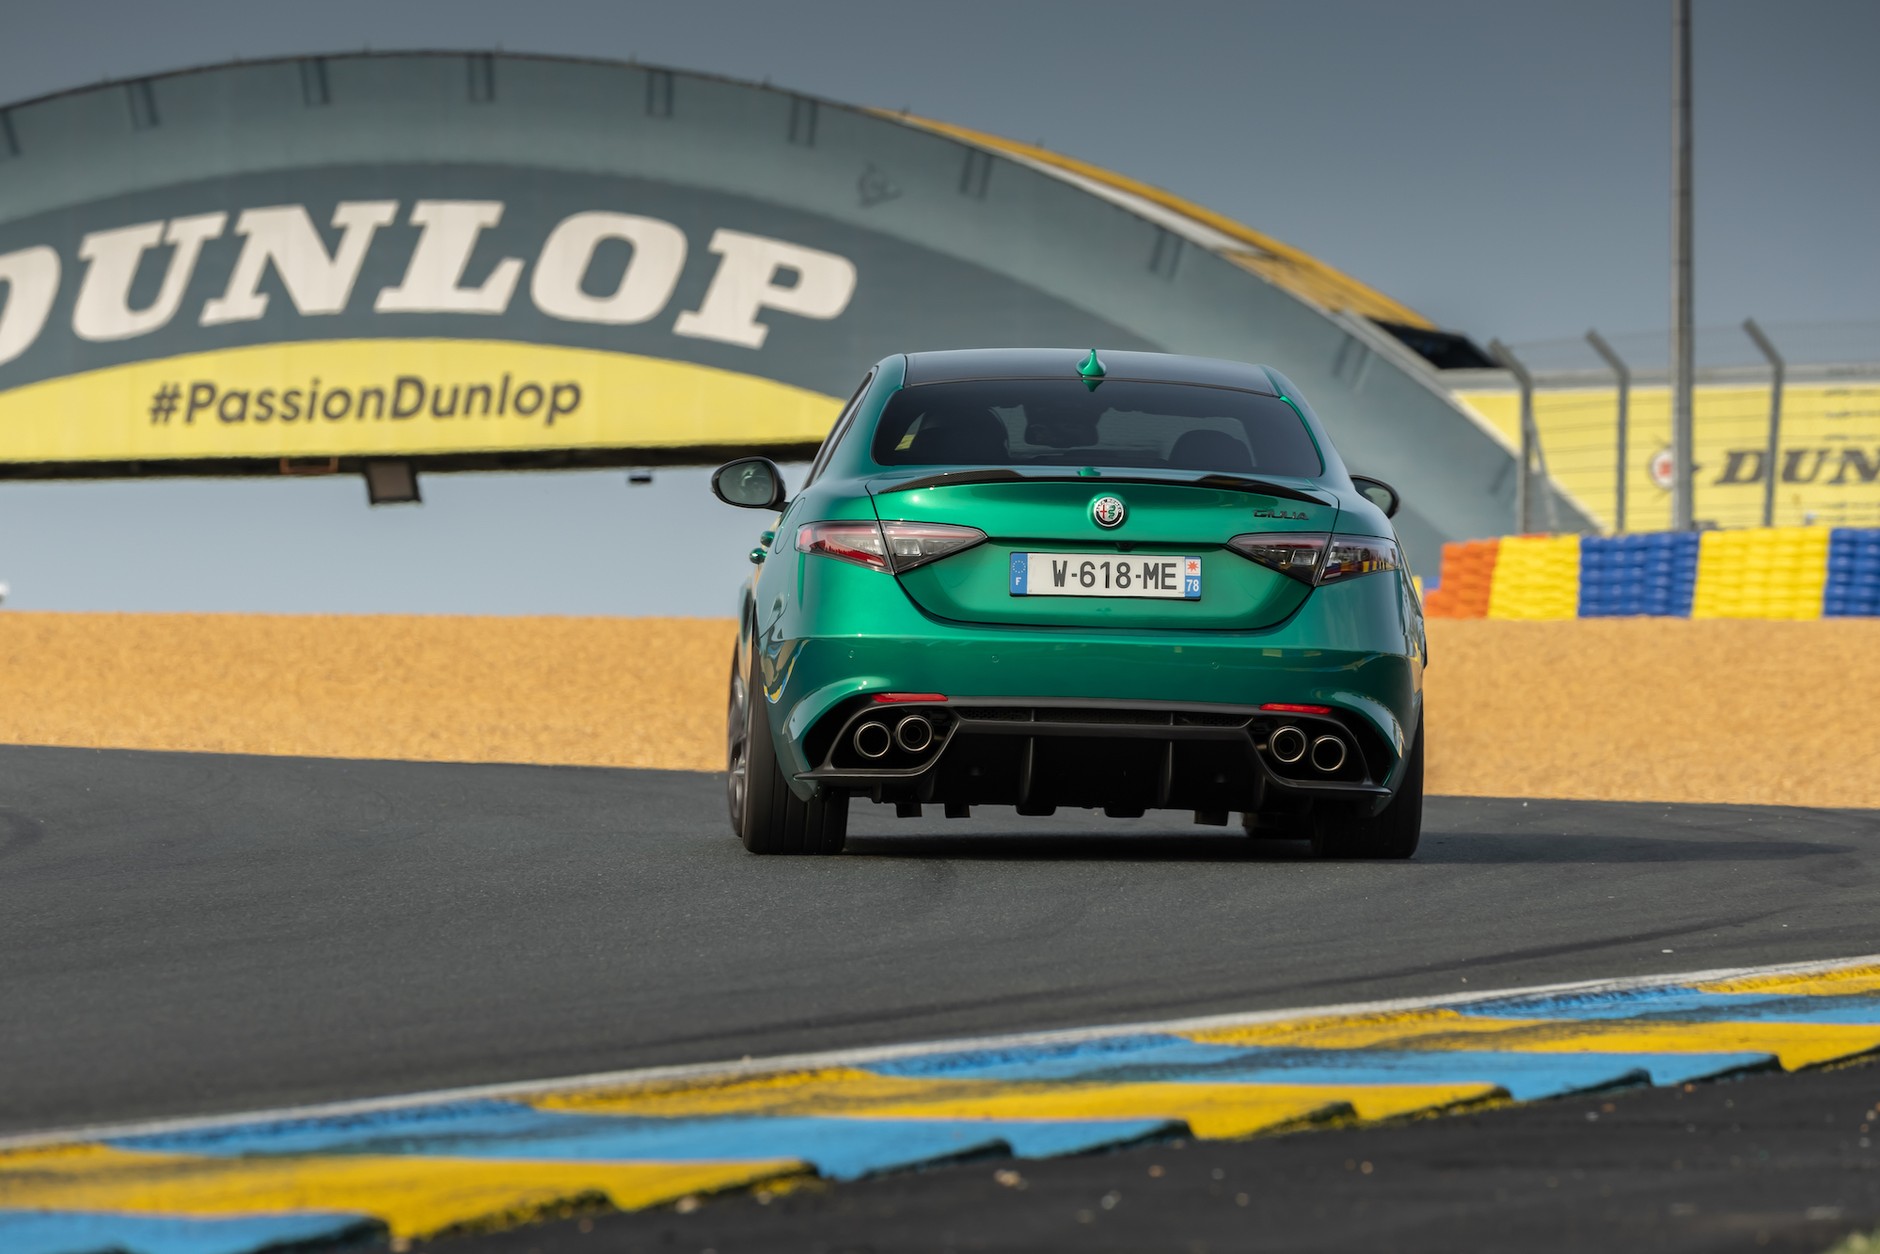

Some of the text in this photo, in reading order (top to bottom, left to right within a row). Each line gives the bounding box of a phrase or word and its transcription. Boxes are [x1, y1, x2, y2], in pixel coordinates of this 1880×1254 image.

[149, 373, 582, 427] #PassionDunlop
[1015, 577, 1022, 586] F
[1052, 560, 1177, 590] W-618-ME
[1186, 579, 1200, 592] 78
